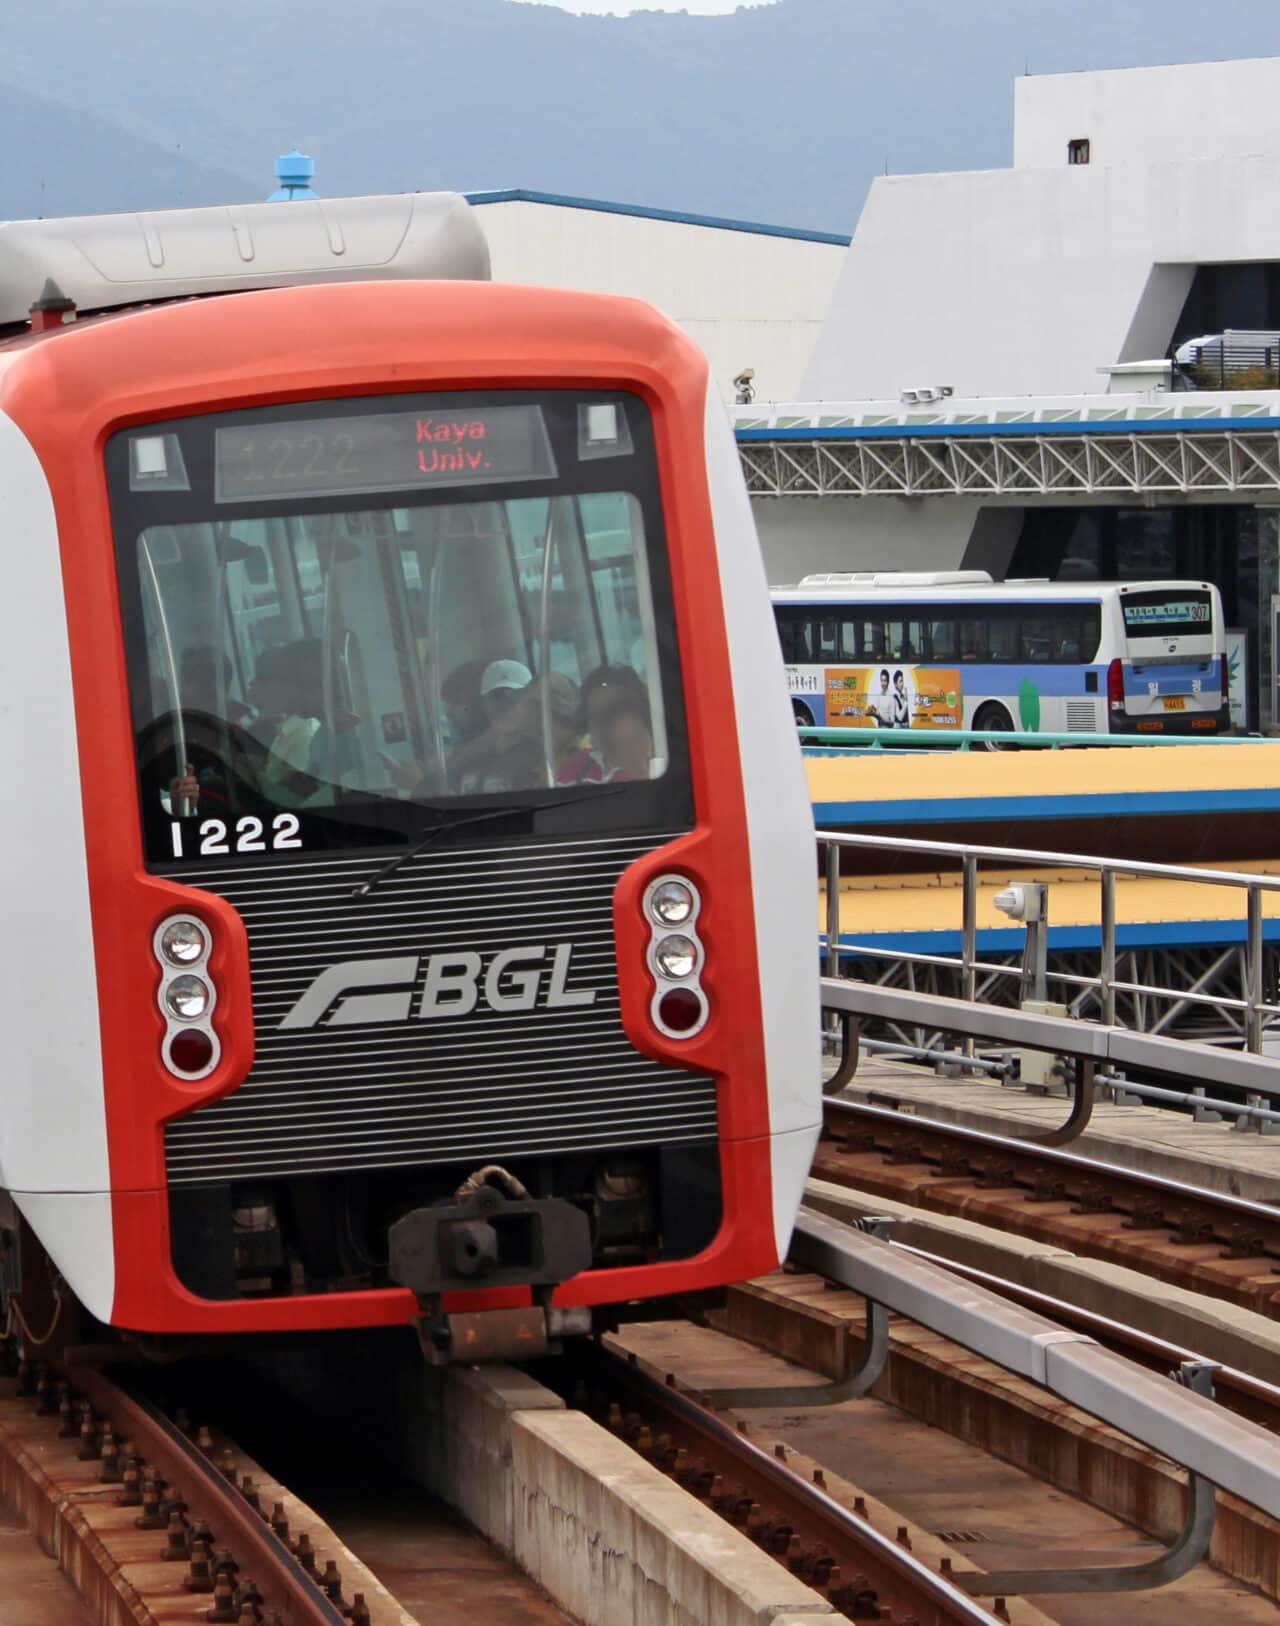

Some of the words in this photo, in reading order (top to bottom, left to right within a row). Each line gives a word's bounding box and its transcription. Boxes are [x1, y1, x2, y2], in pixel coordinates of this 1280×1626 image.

[416, 418, 486, 444] Kaya
[241, 433, 360, 481] 1222
[417, 447, 492, 473] Univ.
[1191, 605, 1208, 620] 307
[171, 812, 303, 858] 1222
[419, 942, 597, 1019] BGL
